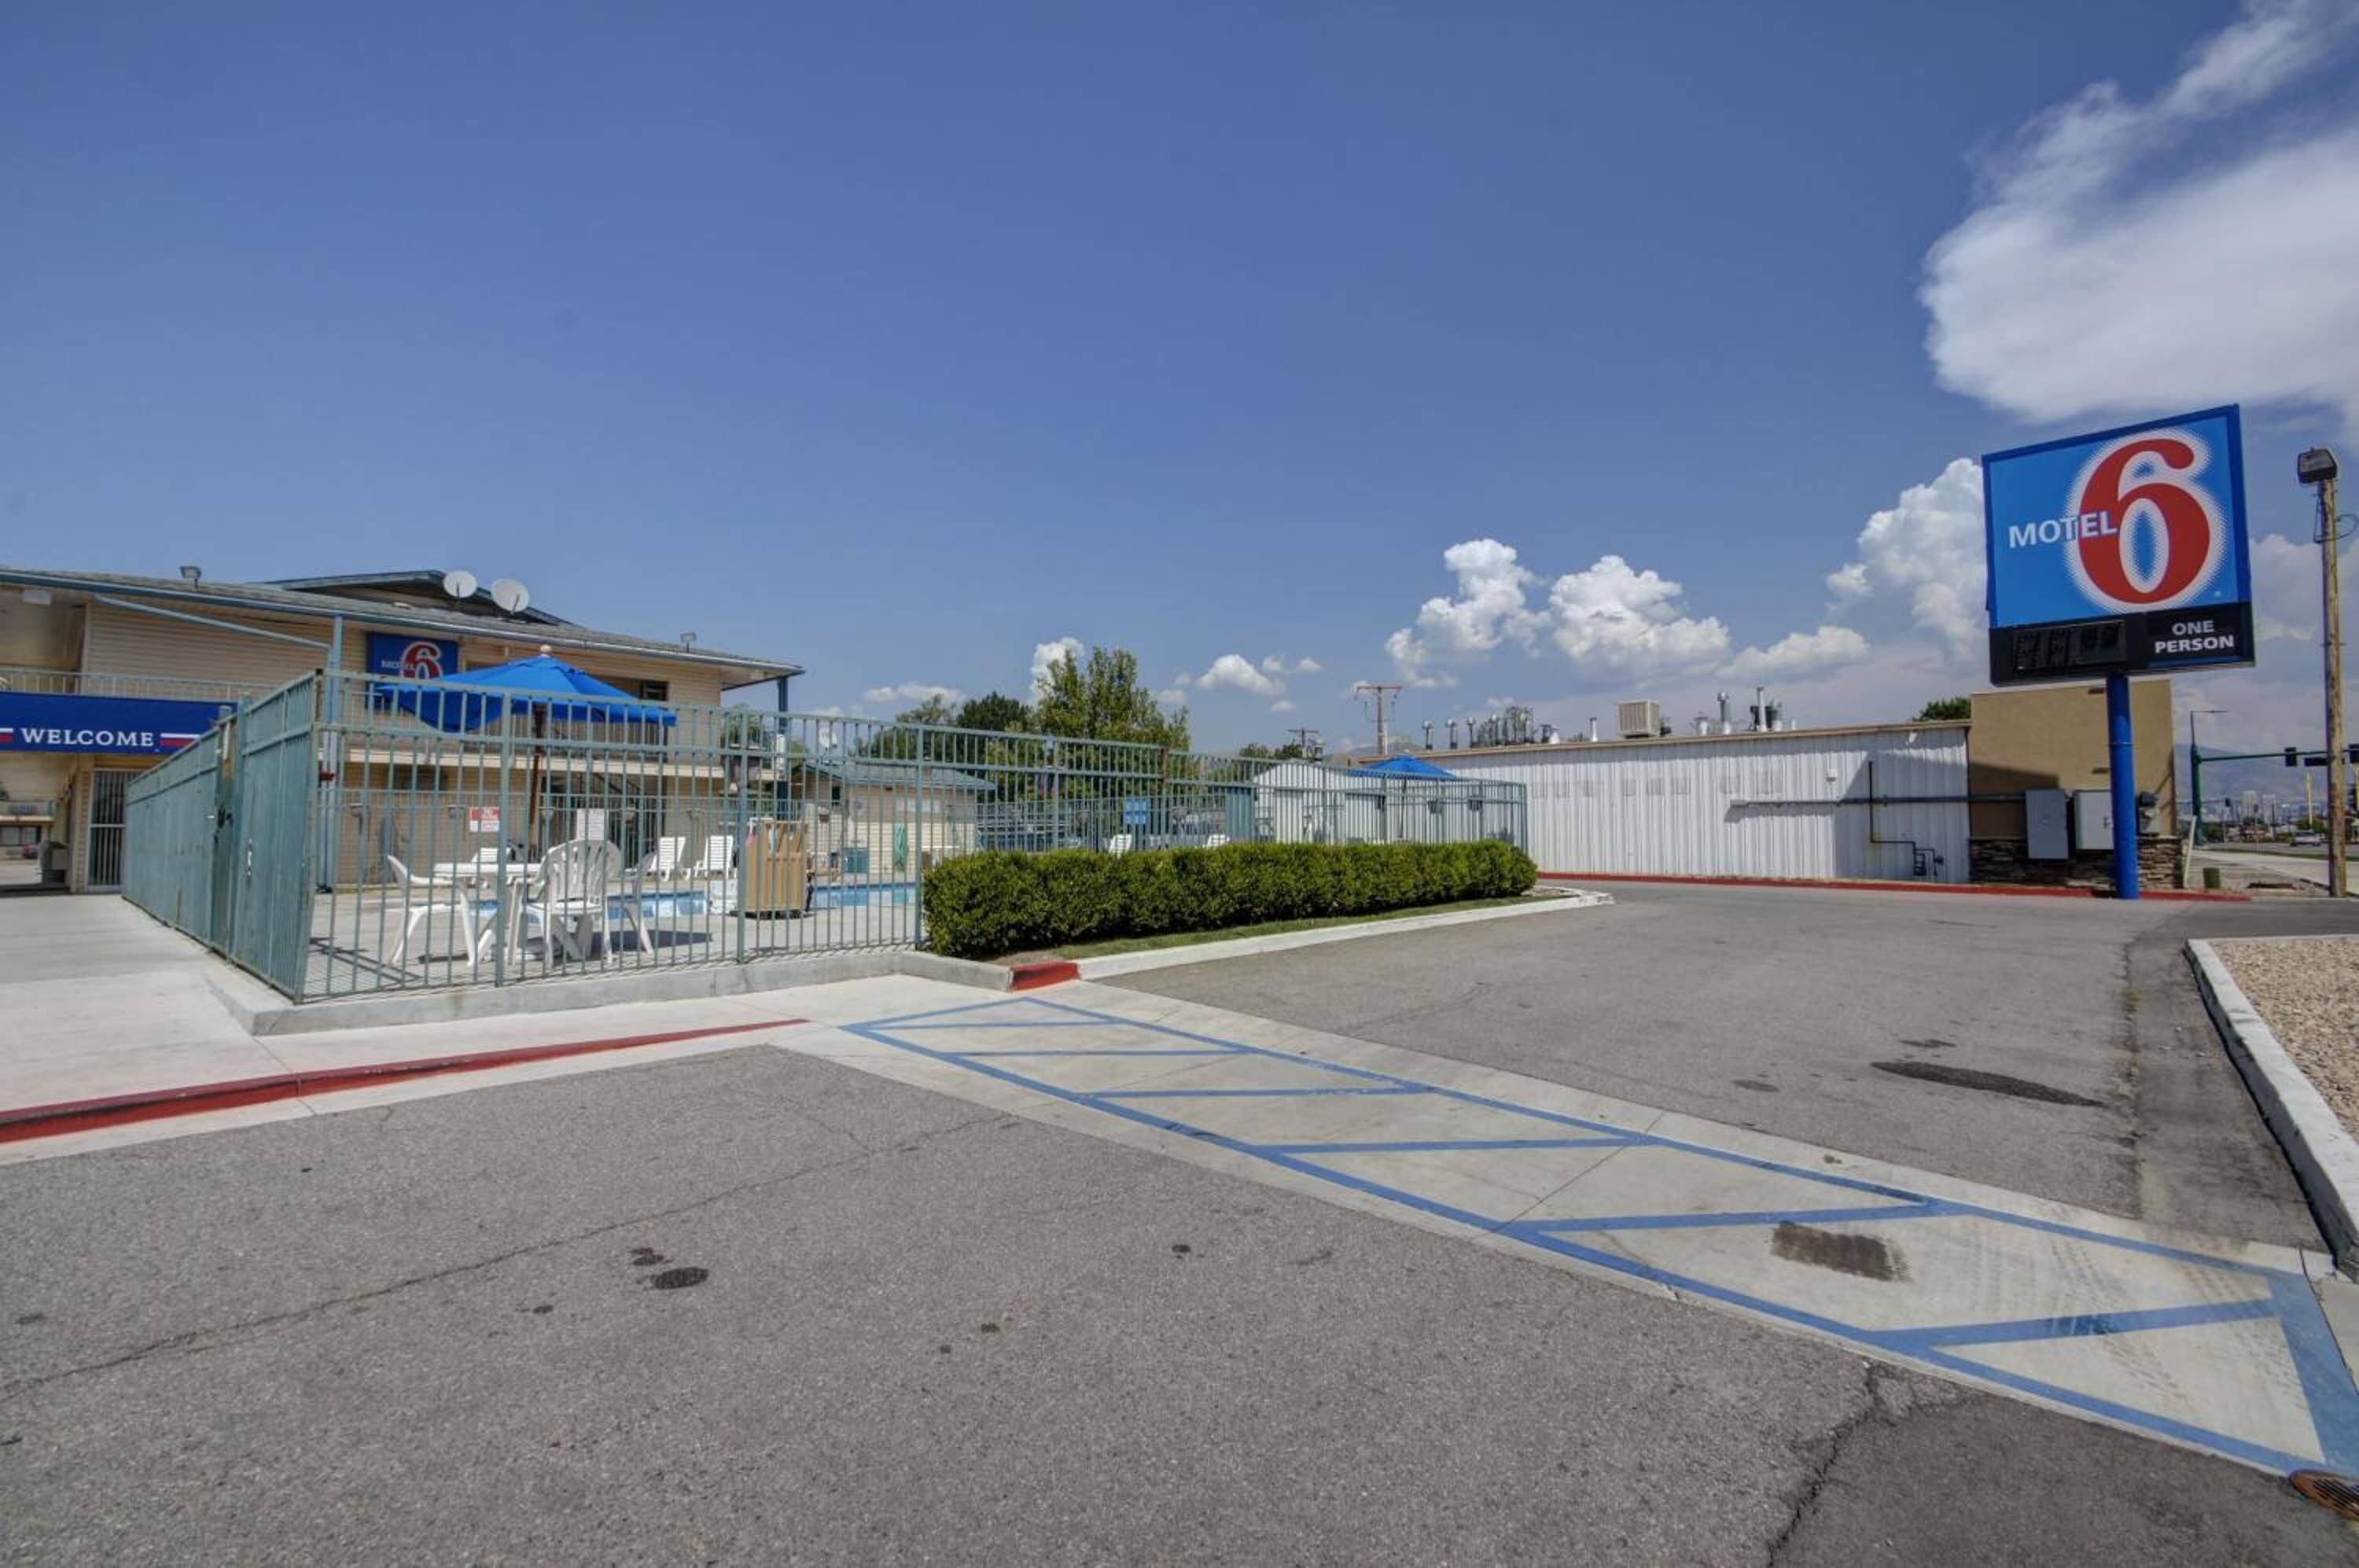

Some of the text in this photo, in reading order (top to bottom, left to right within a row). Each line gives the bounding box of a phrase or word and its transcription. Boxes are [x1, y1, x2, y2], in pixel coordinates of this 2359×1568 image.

[2008, 438, 2210, 605] MOTEL 6
[2171, 620, 2215, 635] ONE
[2155, 635, 2235, 653] PERSON
[20, 727, 154, 746] WELCOME
